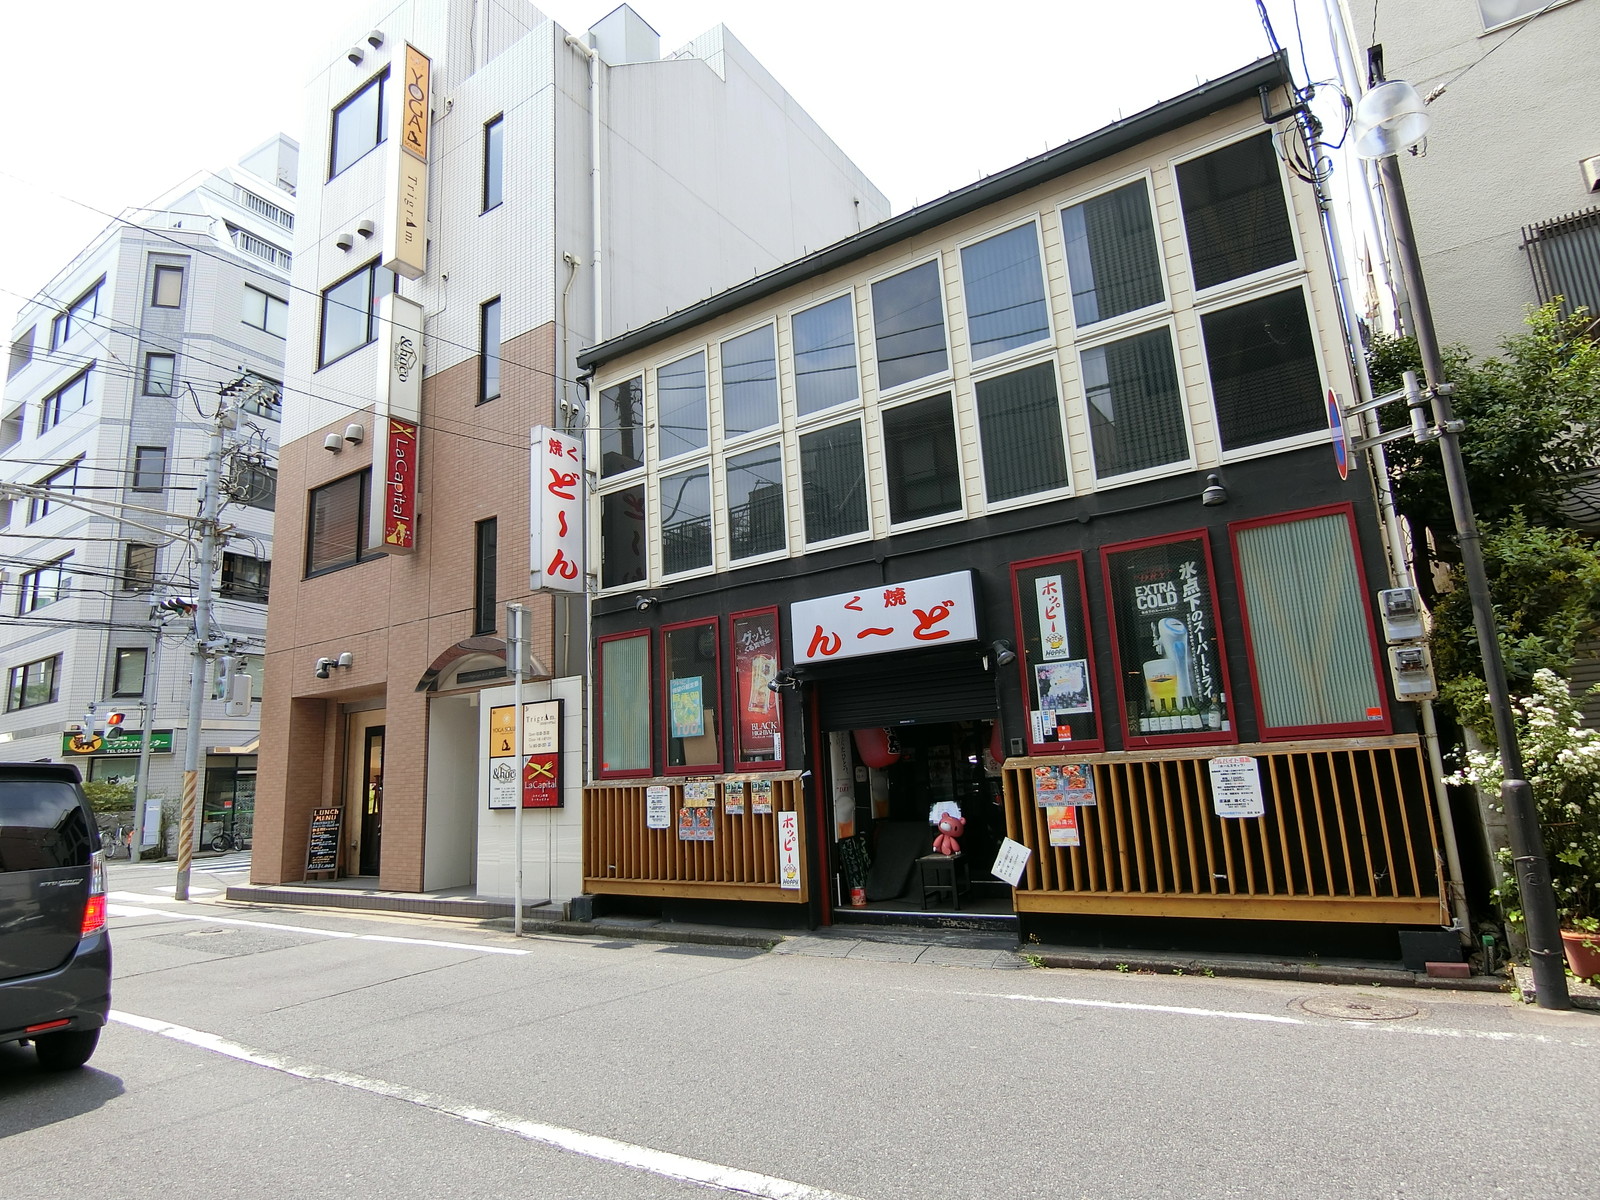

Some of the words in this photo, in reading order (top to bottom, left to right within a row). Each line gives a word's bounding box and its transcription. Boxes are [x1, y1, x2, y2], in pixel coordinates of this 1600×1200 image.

[1135, 581, 1176, 598] EXTRA
[1042, 580, 1061, 632] ホッピー
[1136, 592, 1178, 610] COLD
[751, 721, 778, 730] BLACK
[783, 814, 797, 863] ホッピー
